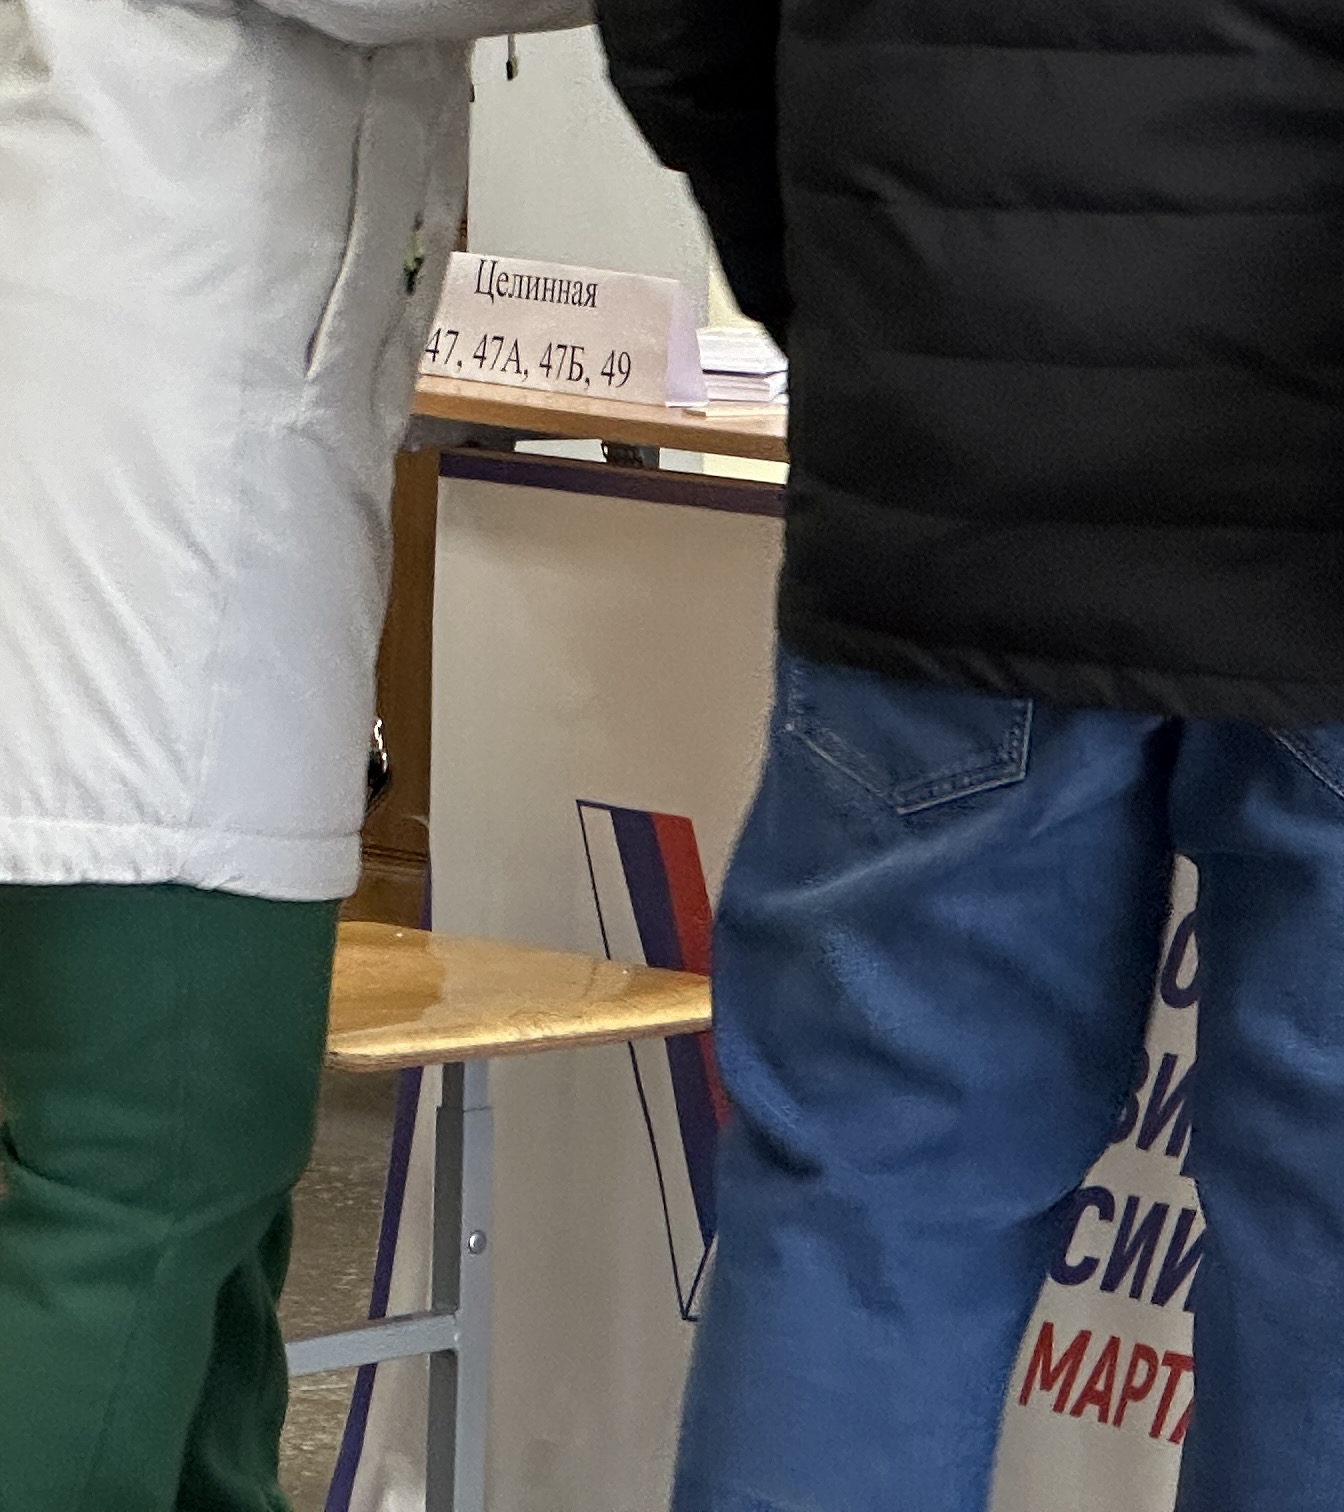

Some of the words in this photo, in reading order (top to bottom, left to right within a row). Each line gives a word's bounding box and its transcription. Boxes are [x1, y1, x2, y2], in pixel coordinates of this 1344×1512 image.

[473, 258, 599, 309] Целинная
[424, 327, 463, 370] 47,
[472, 332, 529, 380] 47А,
[538, 341, 591, 390] 47Б,
[600, 349, 632, 388] 49
[1049, 1186, 1208, 1314] СИИ
